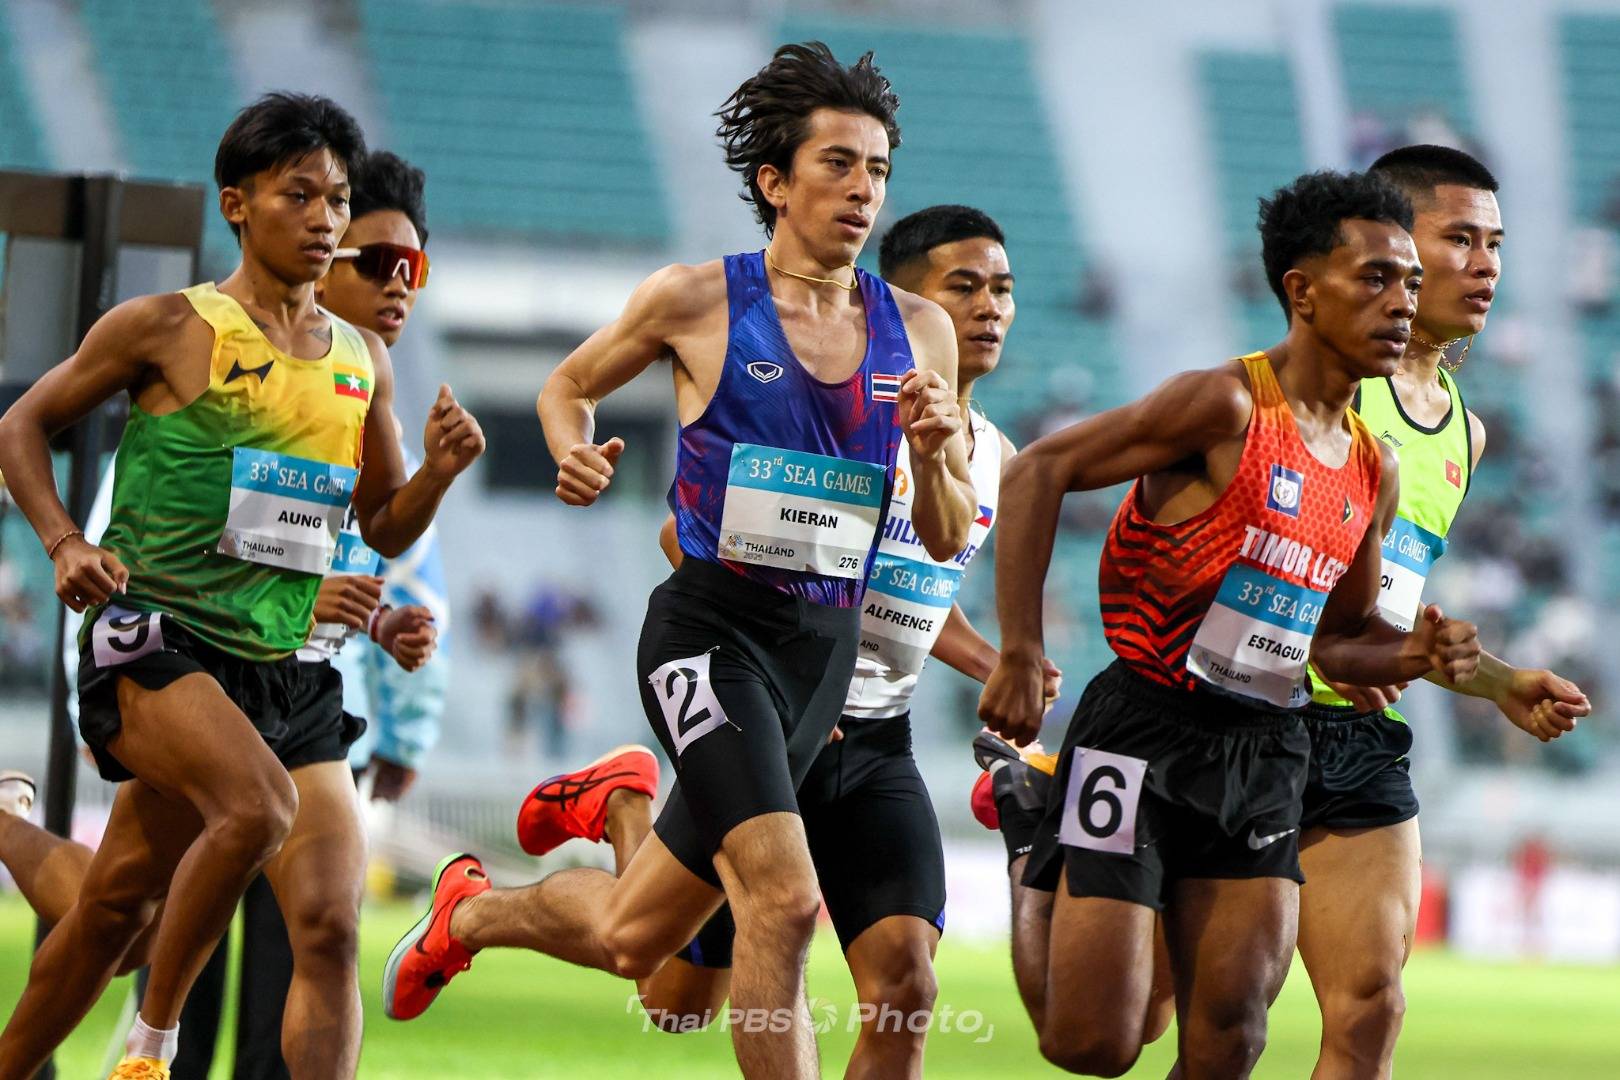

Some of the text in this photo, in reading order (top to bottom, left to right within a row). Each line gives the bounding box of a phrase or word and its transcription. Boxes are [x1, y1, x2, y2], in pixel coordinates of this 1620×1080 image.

[250, 459, 346, 497] 33rd SEA GAMES
[749, 456, 872, 496] 33rd SEA GAMES
[277, 510, 323, 529] AUNG
[779, 507, 839, 530] KIERAN
[242, 540, 285, 557] THAILAND
[744, 542, 859, 570] THAILAND 276
[1239, 525, 1314, 578] TIMOR
[1398, 534, 1430, 563] GAMES
[870, 559, 953, 598] 3rd SEA GAMES
[1380, 574, 1394, 591] OI
[1238, 581, 1276, 606] 33rd
[1268, 593, 1298, 619] SEA
[107, 612, 152, 653] 9
[864, 603, 934, 633] ALFRENCE
[1247, 634, 1305, 663] ESTAGUI
[1209, 662, 1252, 684] THAILAND
[665, 667, 712, 739] 2
[1078, 765, 1127, 839] 6
